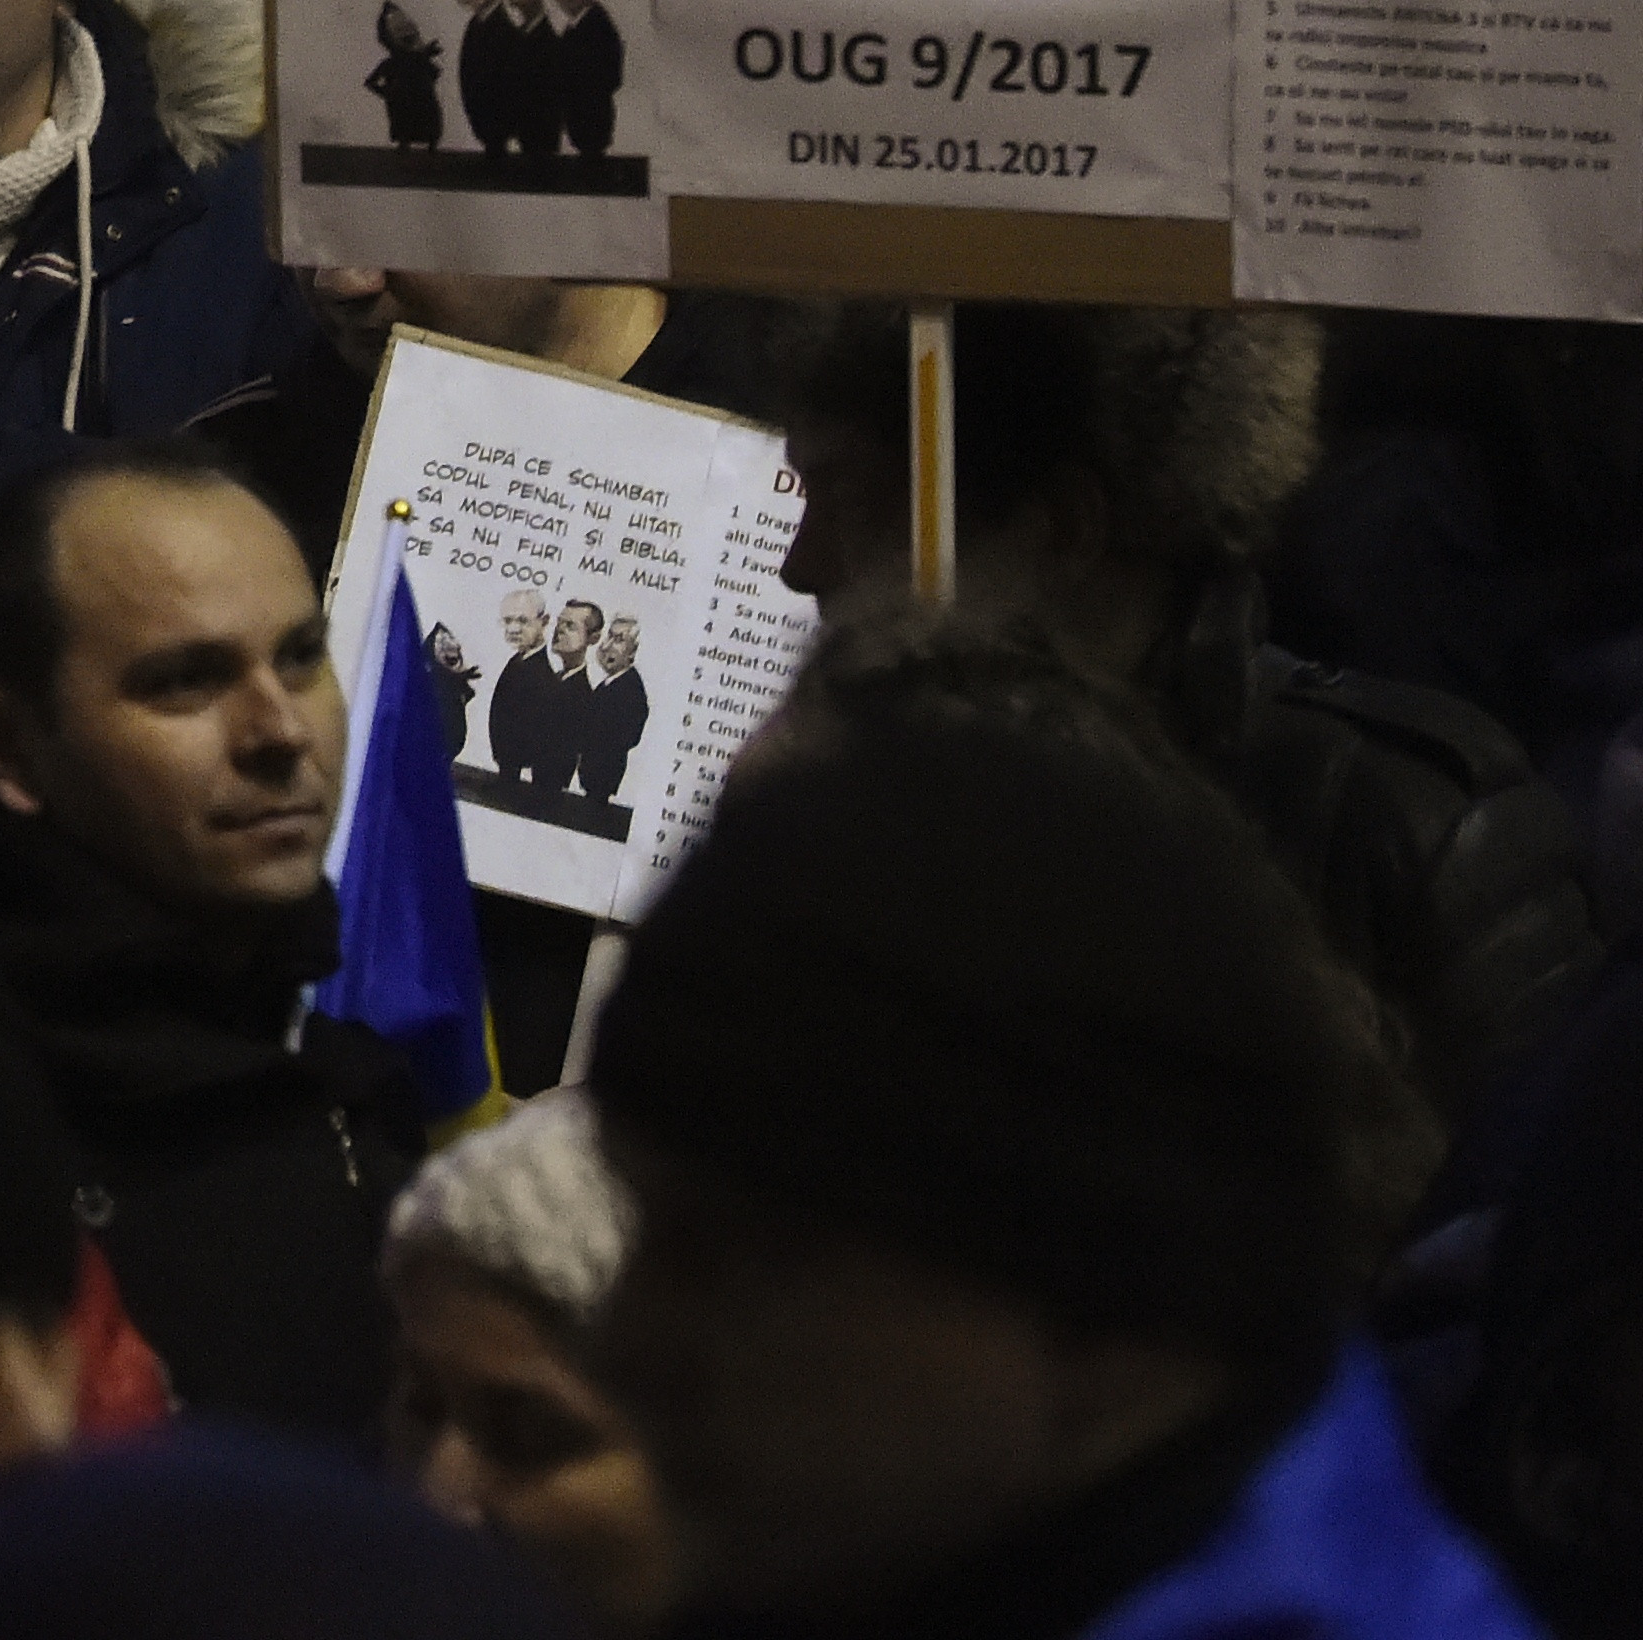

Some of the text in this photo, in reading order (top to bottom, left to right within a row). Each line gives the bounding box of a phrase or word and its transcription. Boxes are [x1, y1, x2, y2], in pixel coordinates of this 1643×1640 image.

[732, 25, 1154, 102] OUG 9/2017
[787, 129, 1100, 180] DIN 25.01.2017
[422, 460, 490, 489] CODUL
[583, 500, 612, 521] NU
[627, 513, 683, 539] UITATI
[523, 457, 553, 476] CE
[568, 469, 670, 508] SCHIMBATI
[416, 485, 444, 505] SA
[459, 497, 569, 537] MODIFICATI
[585, 528, 604, 547] SI
[730, 504, 740, 519] 1
[405, 536, 433, 557] DE
[449, 548, 493, 572] 200
[500, 561, 548, 587] 000
[429, 516, 456, 536] SA
[471, 526, 501, 548] NU
[516, 538, 564, 563] FURI
[577, 556, 614, 577] MAI
[628, 568, 682, 594] MULT
[719, 551, 730, 565] 2
